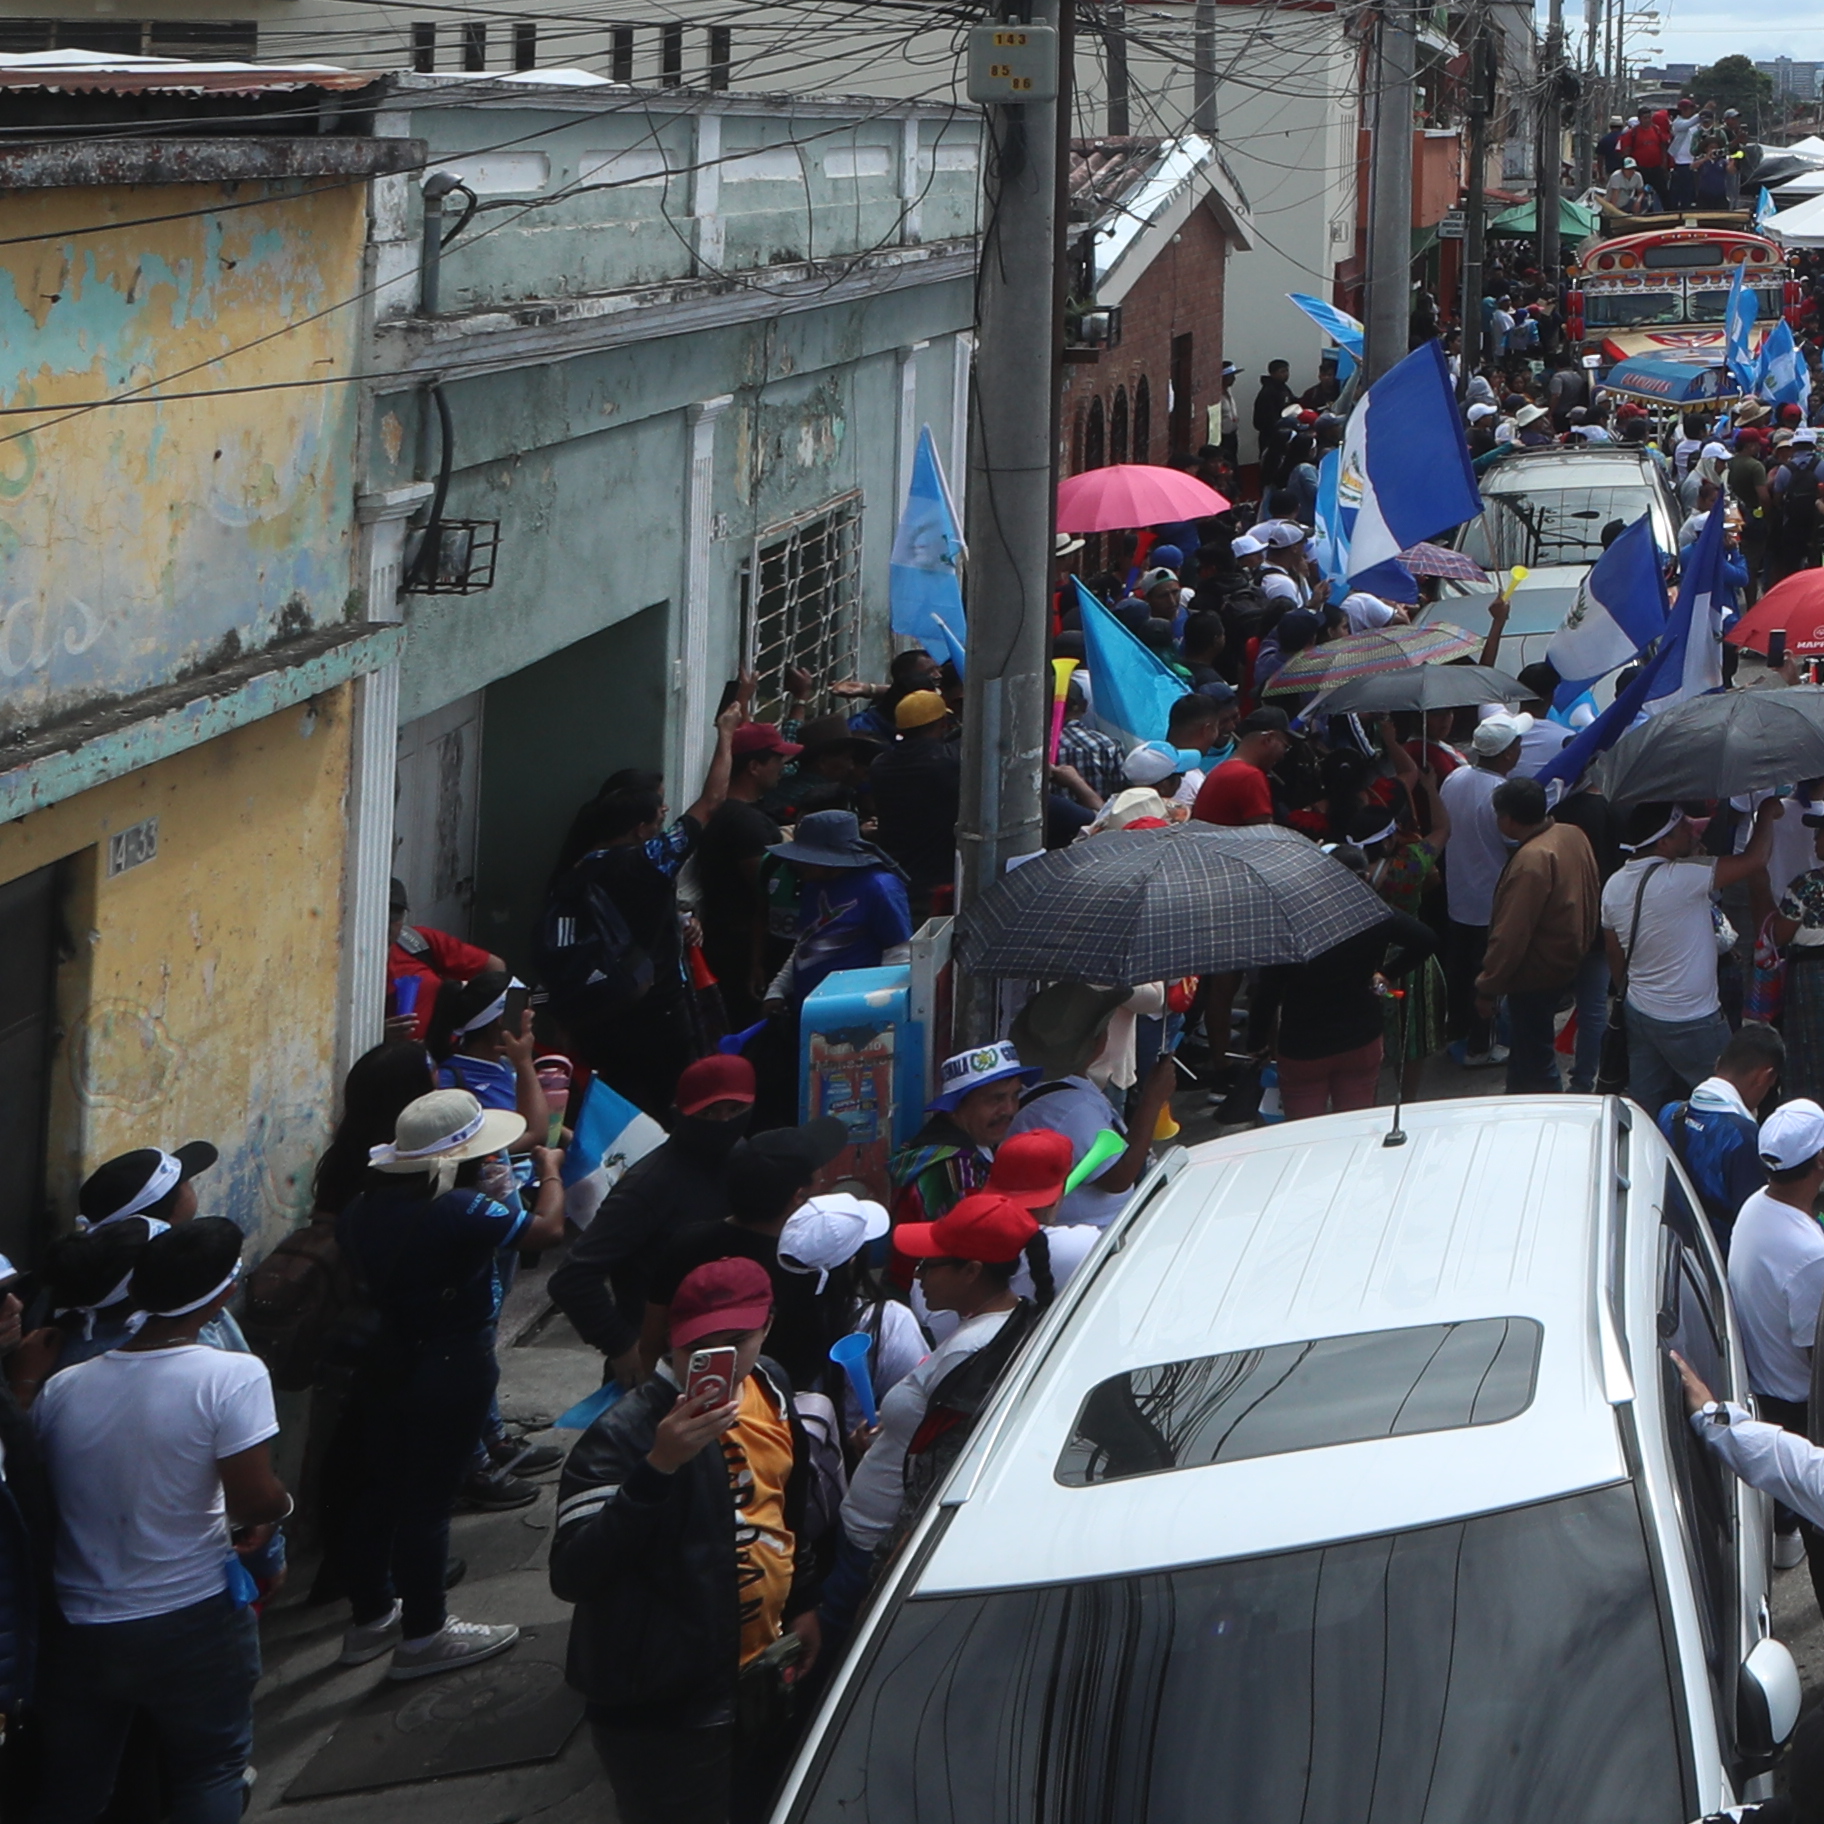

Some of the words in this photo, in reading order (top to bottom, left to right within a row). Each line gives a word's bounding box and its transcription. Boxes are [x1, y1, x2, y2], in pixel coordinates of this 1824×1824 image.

[995, 33, 1027, 46] 143
[991, 64, 1010, 76] 85
[1012, 77, 1031, 89] 86
